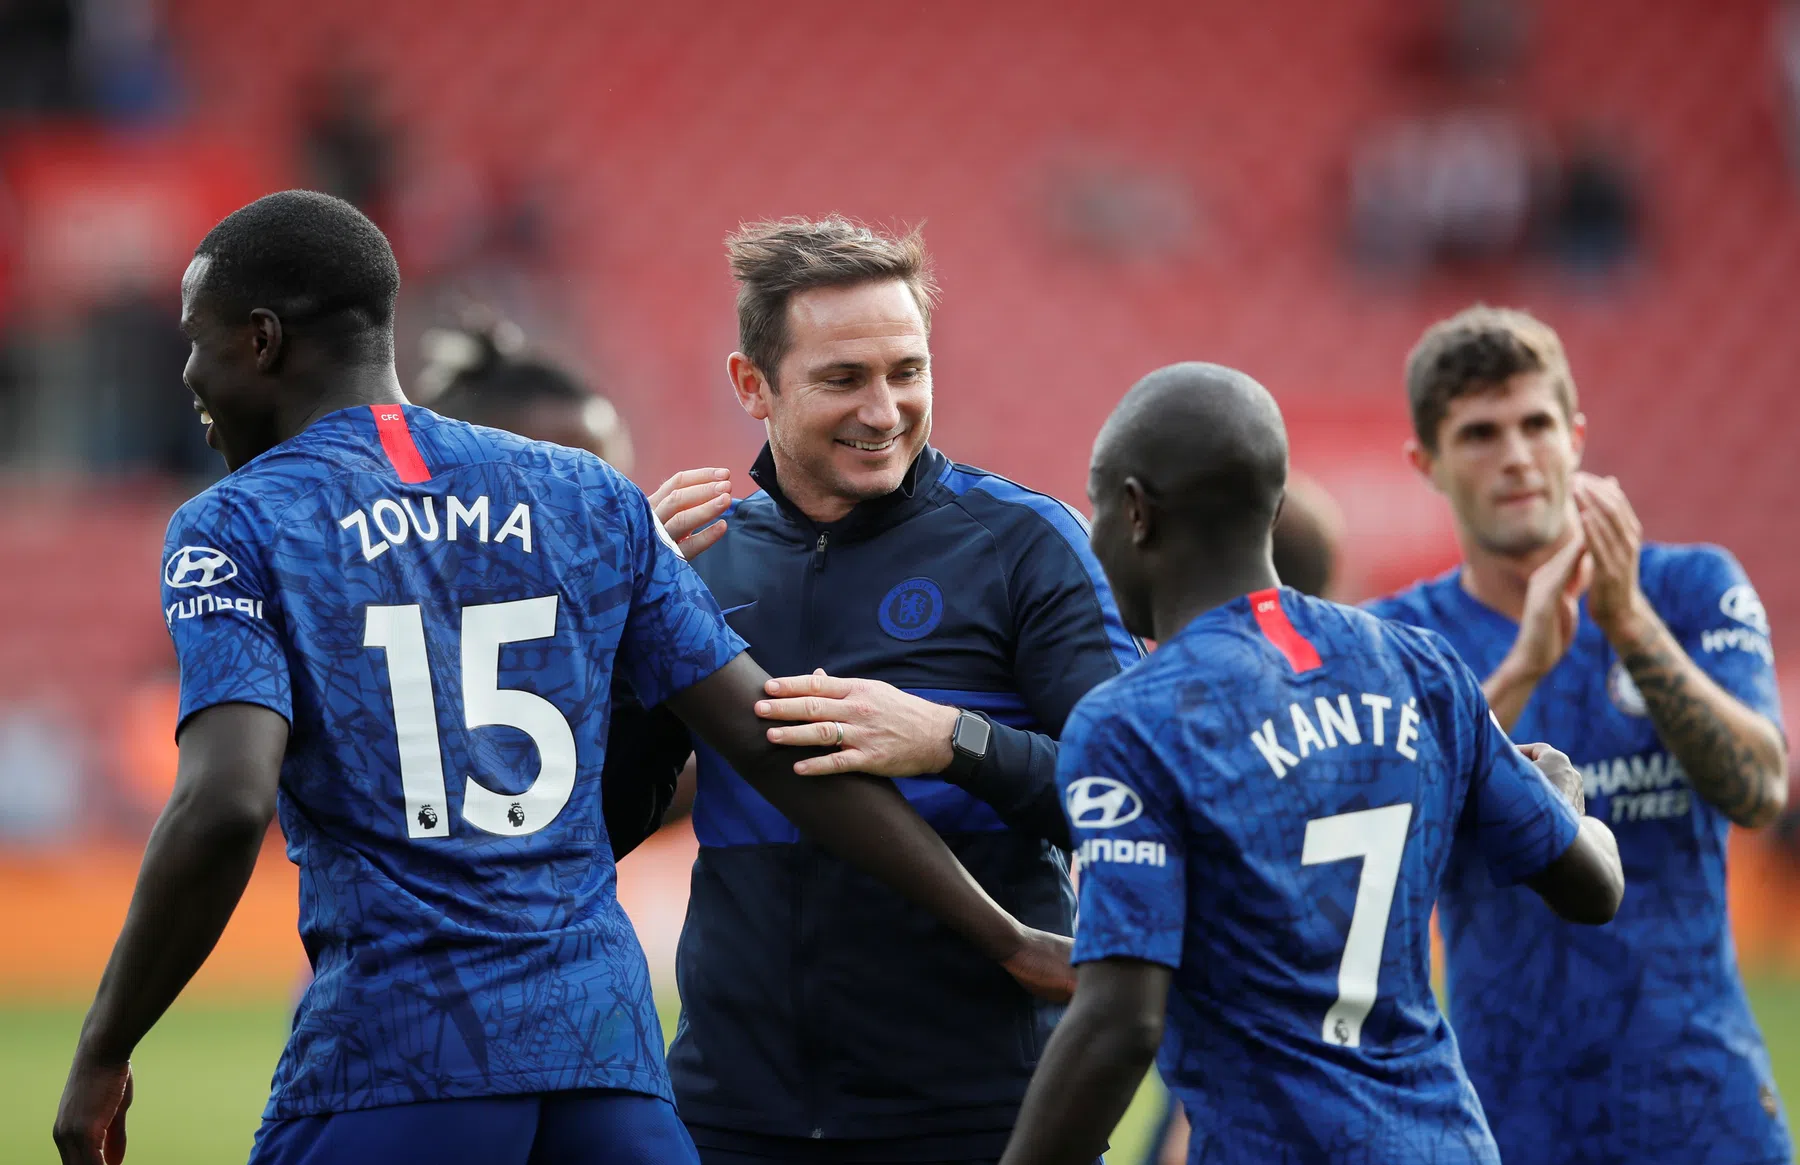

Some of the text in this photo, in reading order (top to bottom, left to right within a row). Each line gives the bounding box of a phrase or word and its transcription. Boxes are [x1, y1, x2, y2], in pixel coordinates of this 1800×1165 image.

[381, 413, 400, 421] CFC
[340, 495, 533, 563] ZOUMA
[165, 593, 264, 624] YUNDAI
[363, 594, 578, 839] 15
[1250, 693, 1421, 779] KANTÉ
[1300, 802, 1413, 1049] 7
